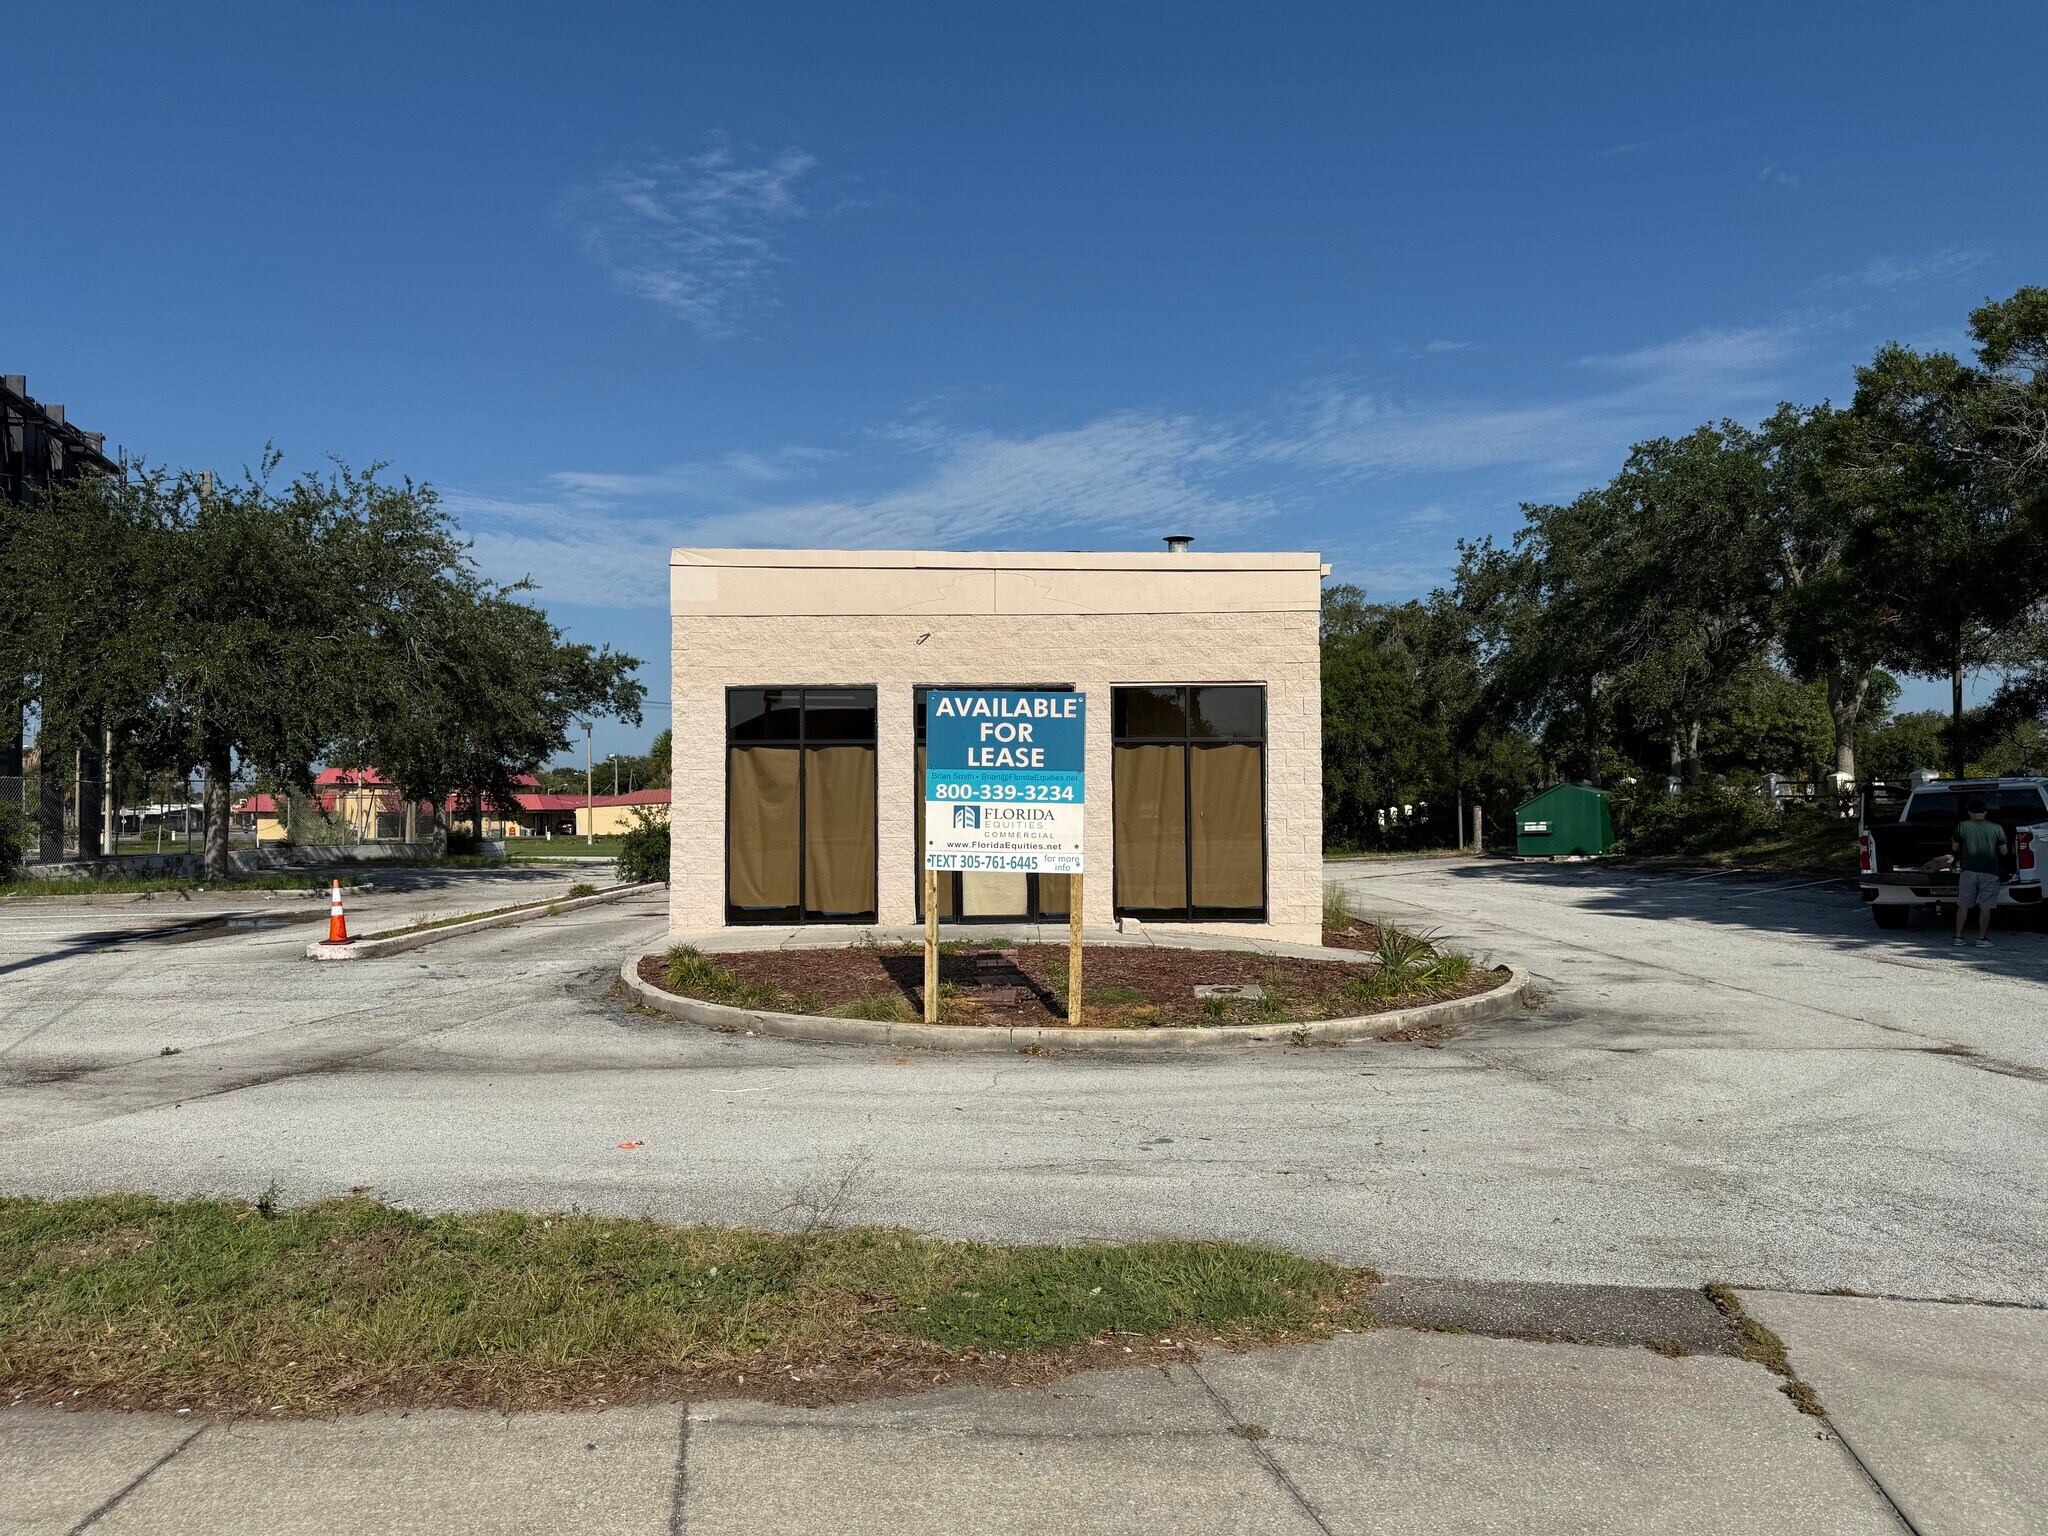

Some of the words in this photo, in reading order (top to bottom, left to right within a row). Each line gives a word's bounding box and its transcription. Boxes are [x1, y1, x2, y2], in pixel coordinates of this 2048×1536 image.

[936, 698, 1077, 718] AVAILABLE
[980, 722, 1033, 742] FOR
[968, 748, 1044, 767] LEASE
[981, 774, 1078, 782] Brian@FloridaEquities.net
[936, 784, 1073, 801] 800-339-3234
[984, 808, 1055, 820] FLORIDA
[985, 821, 1043, 829] EQUITIES
[947, 841, 1061, 850] www.FloridaEquities.net
[929, 854, 957, 868] TEXT
[960, 855, 1038, 870] 305-761-6445
[1044, 854, 1056, 863] for
